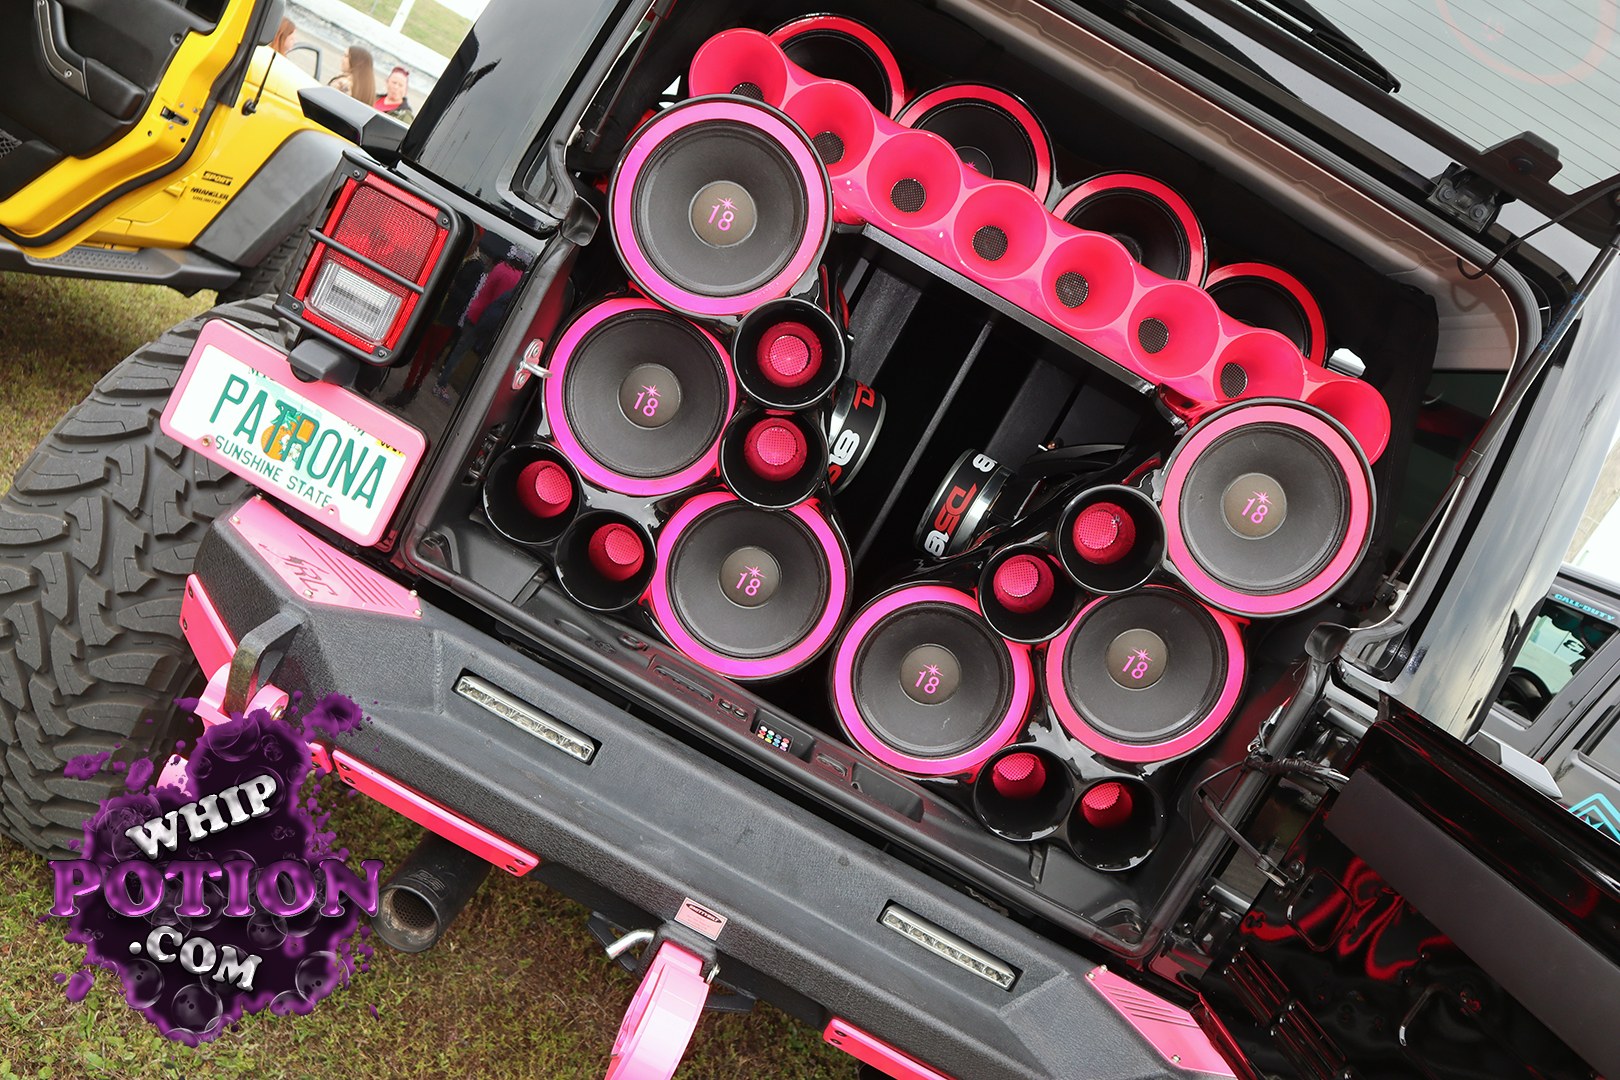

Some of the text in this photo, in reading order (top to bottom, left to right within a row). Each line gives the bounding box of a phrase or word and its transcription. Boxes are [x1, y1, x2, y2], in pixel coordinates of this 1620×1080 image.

[203, 171, 232, 186] SPORT
[190, 187, 229, 200] WRANGLER
[708, 204, 735, 231] 18
[633, 391, 659, 417] 18
[209, 373, 387, 509] PATRONA
[215, 435, 333, 507] SUNSHINE STATE
[924, 483, 977, 557] DS18
[1241, 498, 1269, 524] 18
[736, 572, 761, 597] 18
[1122, 655, 1148, 679] 18
[915, 670, 940, 695] 18
